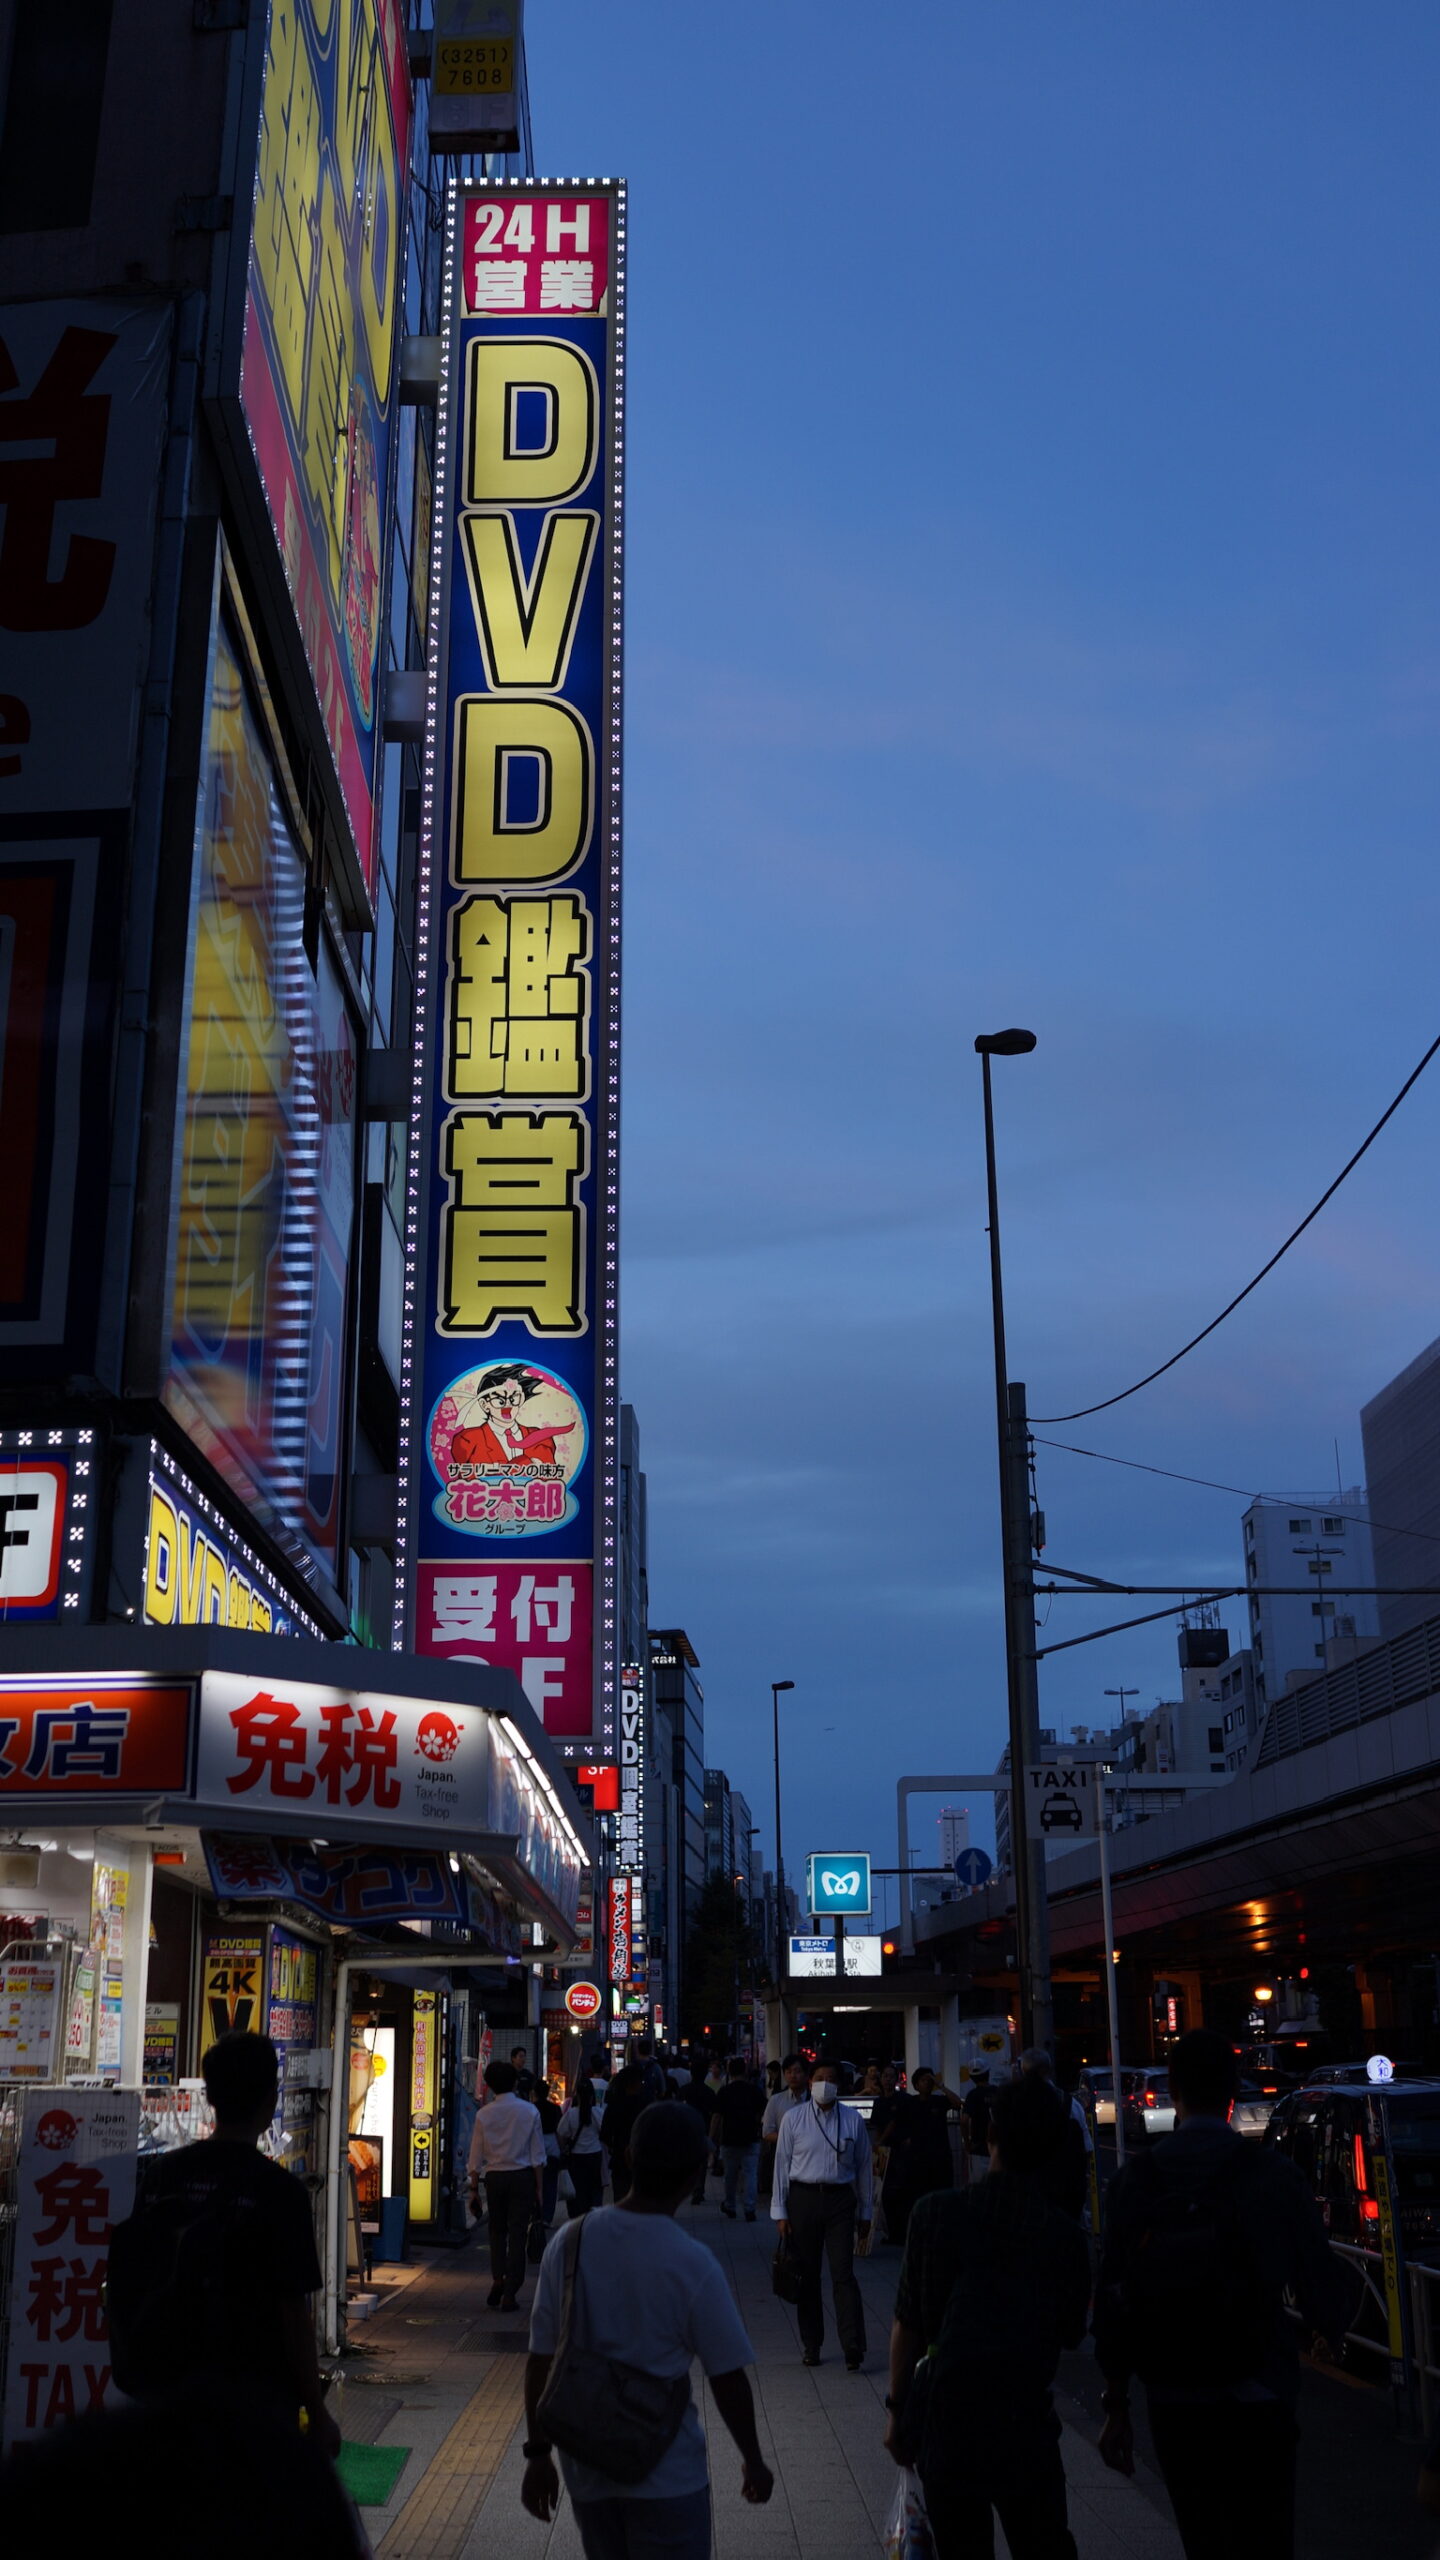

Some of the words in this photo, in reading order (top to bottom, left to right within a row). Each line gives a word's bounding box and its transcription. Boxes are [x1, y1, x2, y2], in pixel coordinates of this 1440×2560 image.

[441, 47, 508, 64] (3251)
[448, 69, 501, 86] 7608
[474, 260, 594, 309] 営業
[448, 1463, 565, 1477] サラリーマンの味方
[447, 1480, 565, 1521] 花太郎
[485, 1523, 526, 1534] グループ
[432, 1575, 575, 1643] 受付
[226, 1691, 402, 1809] 免税
[417, 1768, 457, 1784] Japan.
[1029, 1770, 1087, 1788] TAXI
[414, 1786, 459, 1803] Tax-free
[422, 1804, 450, 1820] Shop
[813, 1958, 857, 1969] 秋葉駅
[209, 1970, 257, 1995] 4K
[1377, 2058, 1389, 2078] 大和
[92, 2112, 128, 2125] Japan.
[87, 2127, 128, 2138] Tax-free
[102, 2139, 128, 2150] Shop
[25, 2162, 115, 2343] 免税
[20, 2364, 113, 2428] TAX
